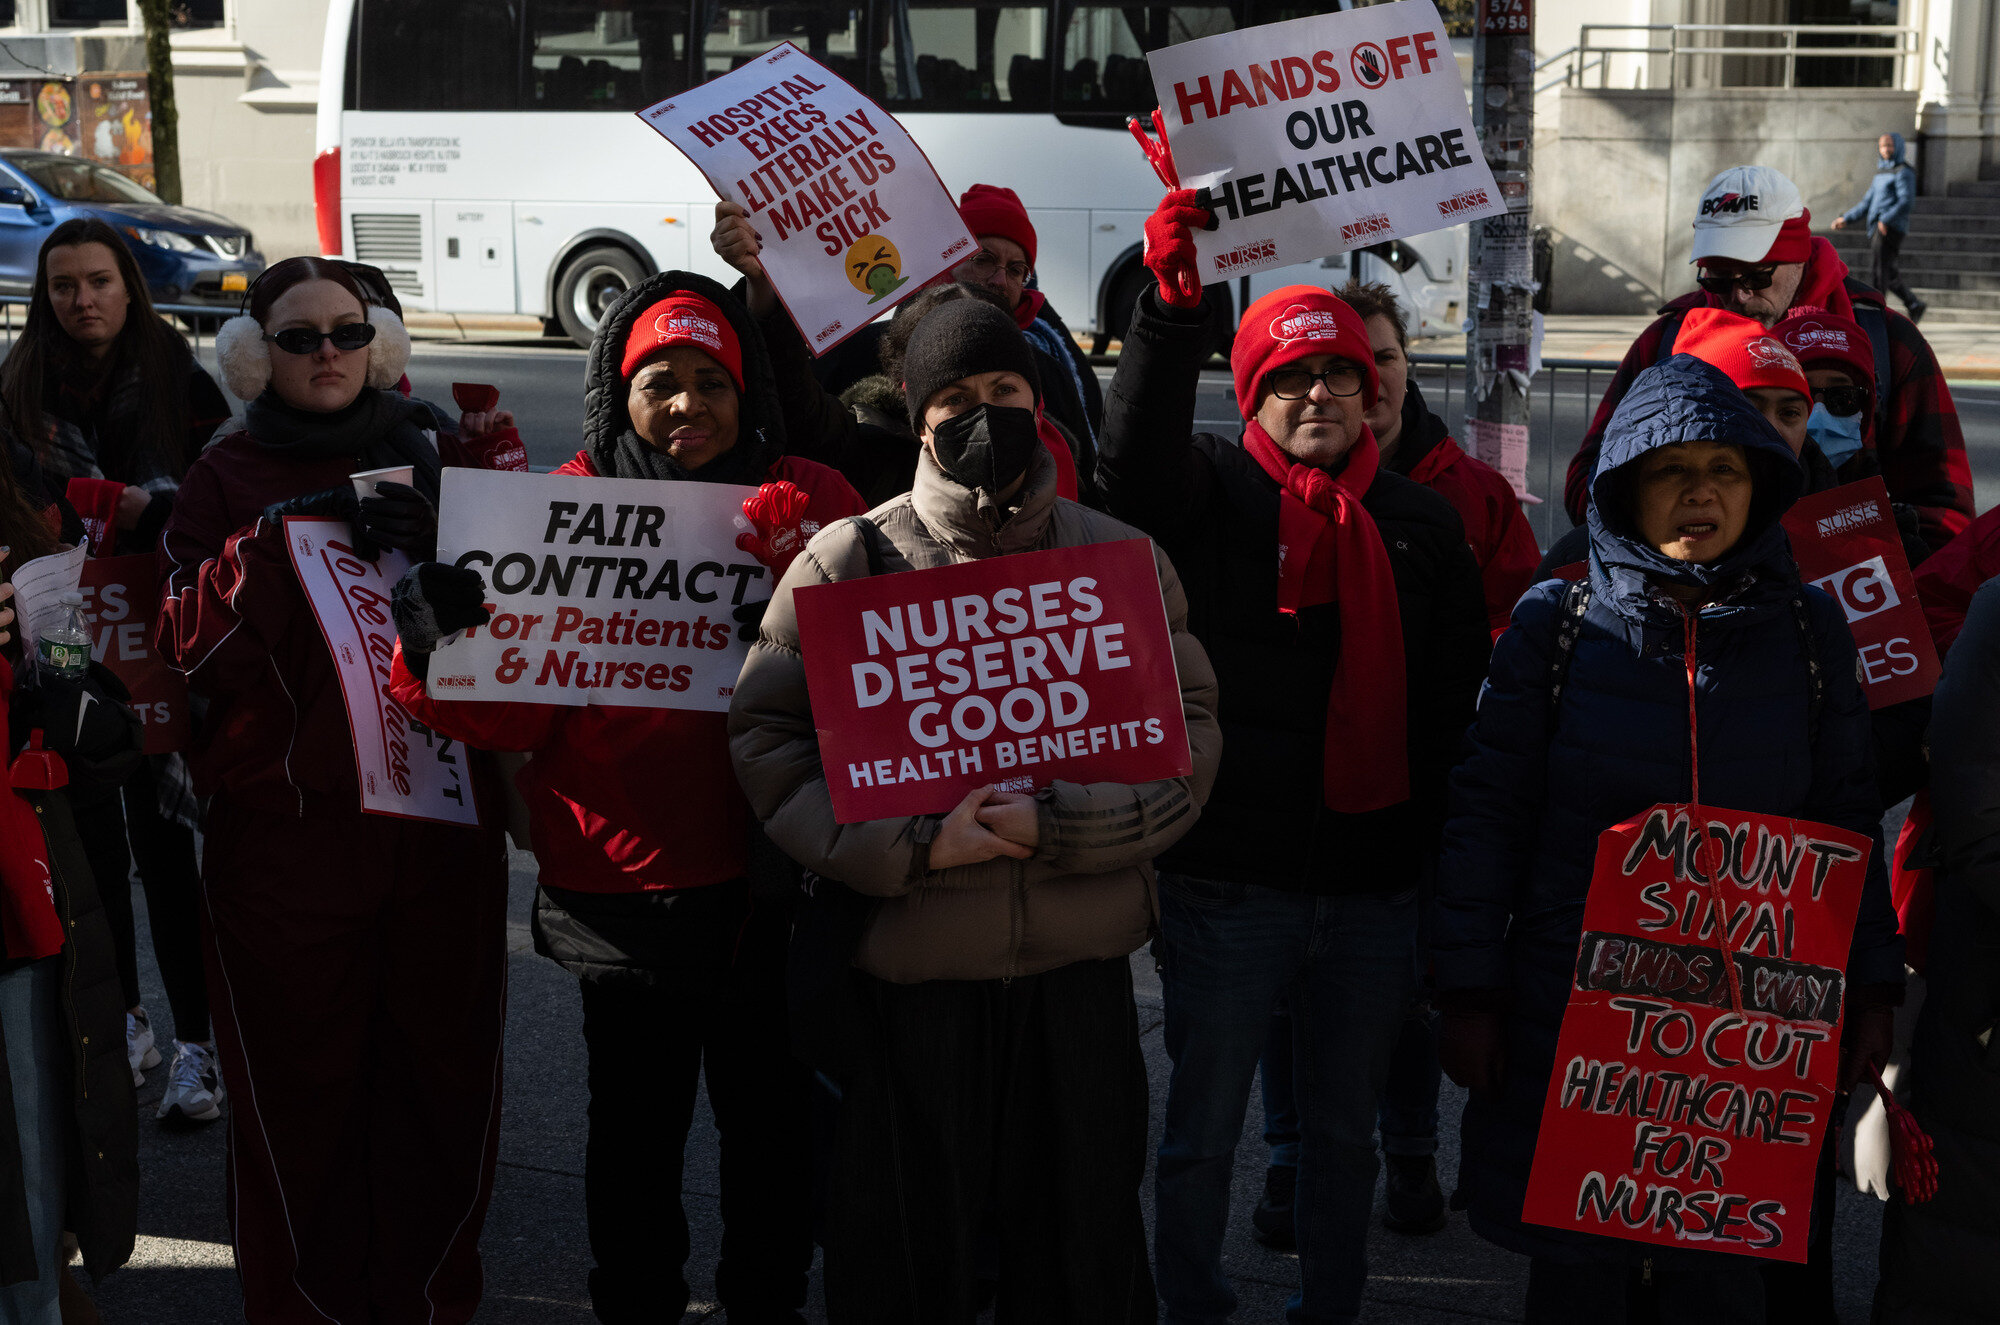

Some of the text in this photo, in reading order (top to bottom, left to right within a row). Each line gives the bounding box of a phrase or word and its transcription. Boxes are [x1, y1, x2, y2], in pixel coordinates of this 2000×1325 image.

[1484, 15, 1528, 29] 4958
[1491, 0, 1523, 12] 574
[1174, 50, 1341, 125] HANDS
[687, 74, 826, 148] HOSPITAL
[1286, 100, 1375, 151] OUR
[737, 108, 878, 213] LITERALLY
[1207, 128, 1473, 221] HEALTHCARE
[767, 140, 896, 241] MAKE US
[1437, 192, 1488, 215] NURSES
[1442, 202, 1493, 219] ASSOCIATION
[1701, 194, 1758, 216] BOWIE
[816, 189, 891, 256] SICK
[1340, 217, 1391, 240] NURSES
[1343, 227, 1395, 246] ASSOCIATION
[1214, 243, 1276, 270] NURSES
[1217, 253, 1280, 275] ASSOCIATION
[668, 318, 719, 336] NURSES
[1281, 315, 1334, 333] NURSES
[1798, 330, 1847, 342] NURSES
[543, 501, 666, 547] FAIR
[1816, 504, 1879, 534] NURSES
[1820, 511, 1882, 539] ASSOCIATION
[349, 585, 391, 625] be
[550, 606, 731, 650] Patients
[862, 576, 1104, 655] NURSES
[437, 677, 476, 687] NURSES
[495, 647, 693, 692] & Nurses
[851, 622, 1131, 708] DESERVE
[909, 681, 1089, 748] GOOD
[848, 717, 1165, 788] HEALTH BENEFITS
[1622, 809, 1862, 901] MOUNT
[1636, 882, 1795, 960] SINAI
[1753, 966, 1832, 1020] WAY
[1609, 997, 1831, 1080] TO CUT
[1560, 1055, 1819, 1146] HEALTHCARE
[1632, 1121, 1731, 1188] FOR
[1575, 1170, 1786, 1249] NURSES
